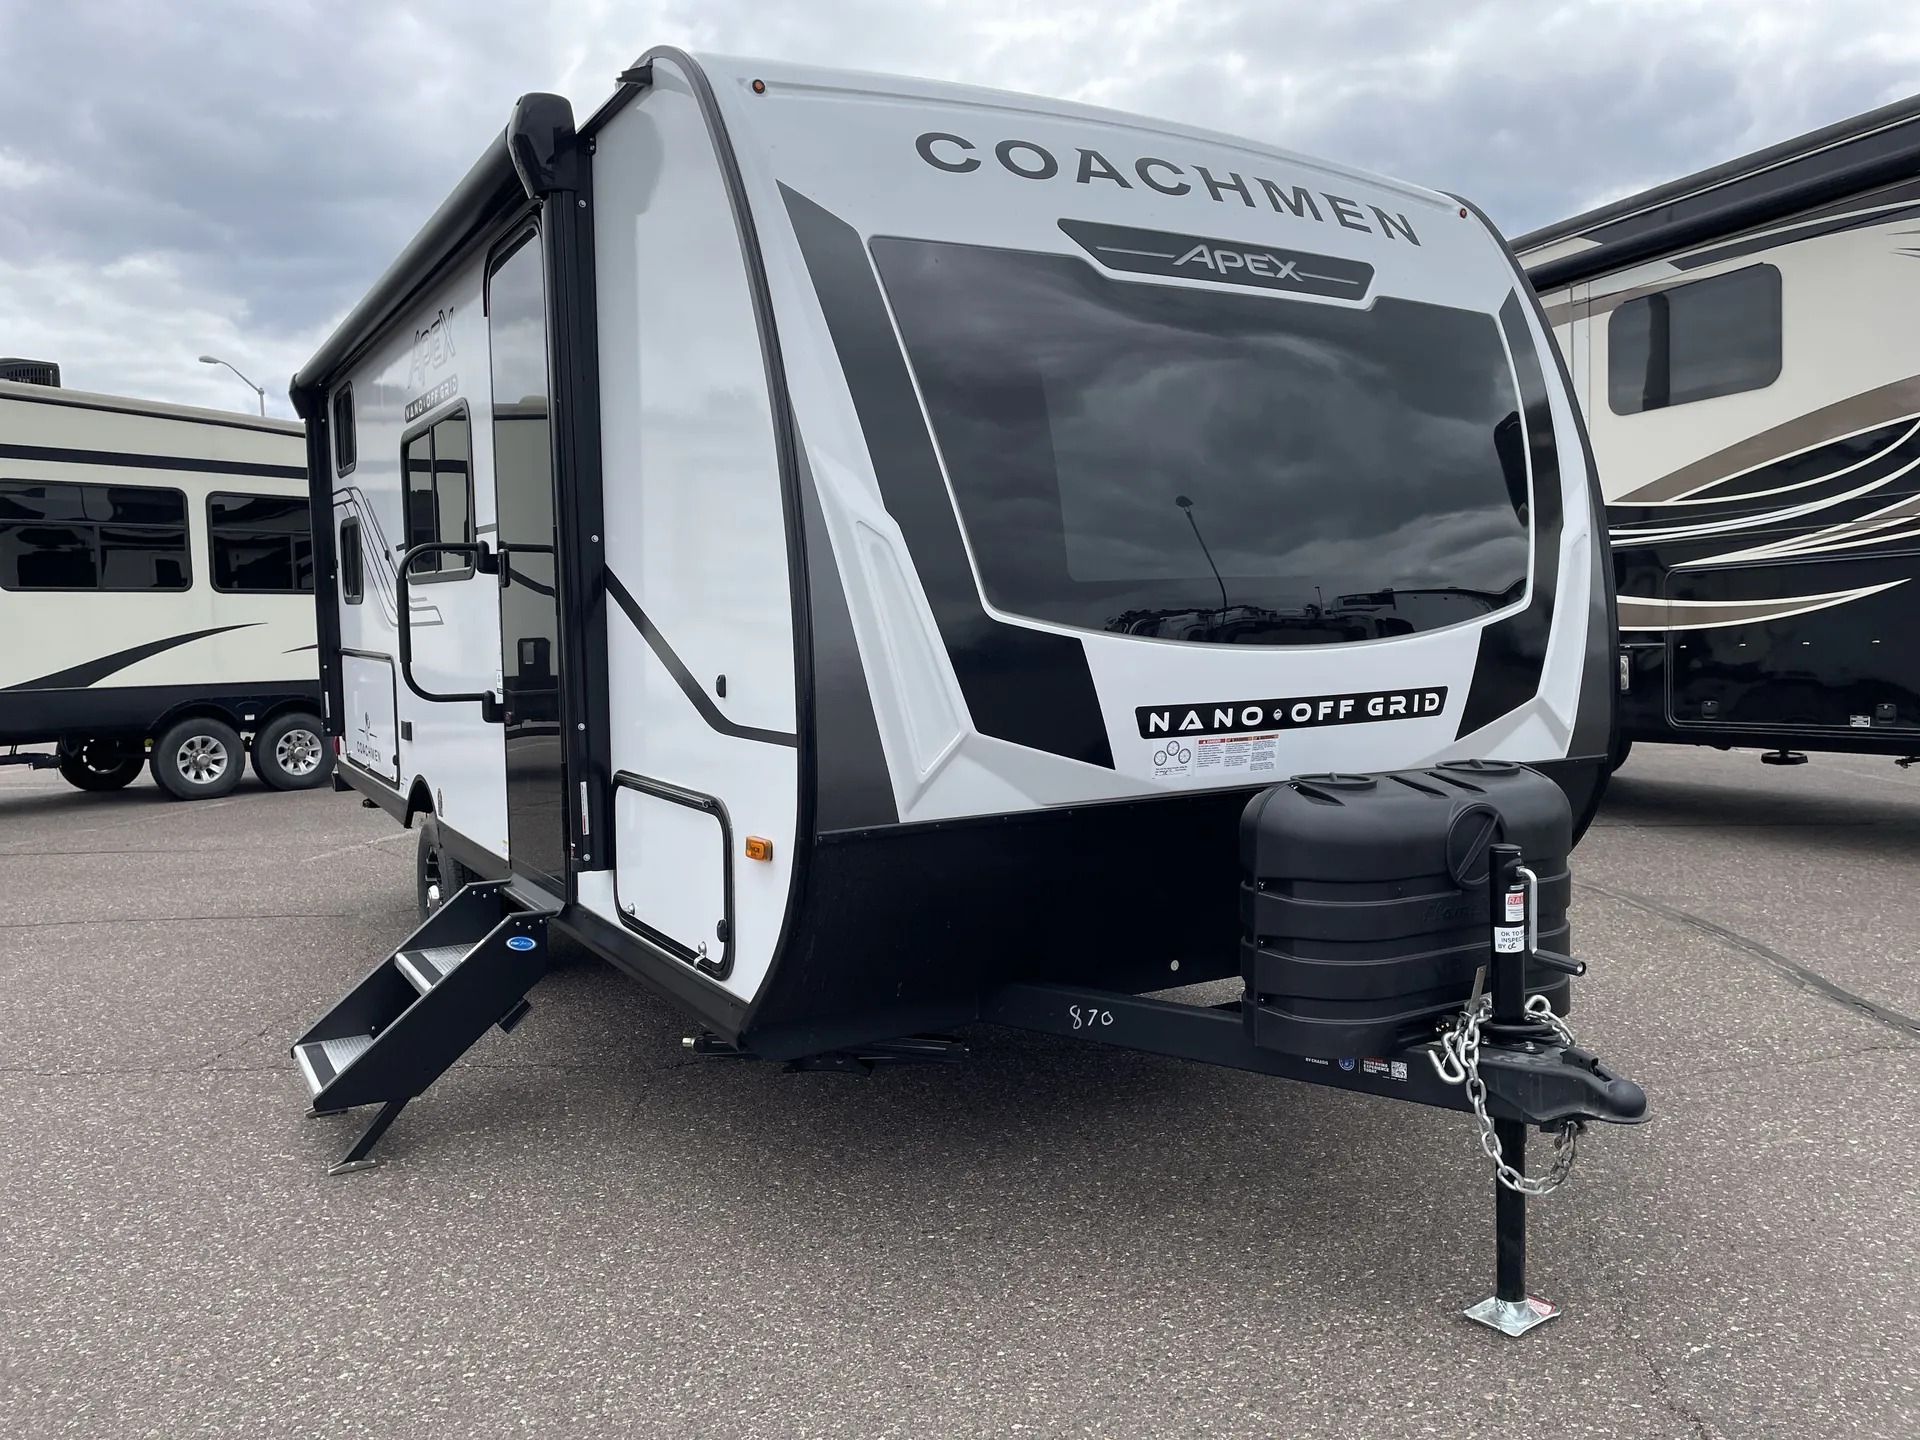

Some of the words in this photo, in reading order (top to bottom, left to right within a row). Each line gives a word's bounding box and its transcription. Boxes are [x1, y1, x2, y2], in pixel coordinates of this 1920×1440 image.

[915, 131, 1422, 248] COACHMEN
[426, 389, 440, 409] OFF
[440, 377, 458, 400] GRID
[1148, 705, 1264, 733] NANO
[1291, 698, 1356, 722] OFF
[1367, 691, 1441, 717] GRID
[356, 740, 382, 763] COACHMEN
[1069, 1004, 1114, 1030] 870
[1363, 1064, 1390, 1072] EXPERIENCE
